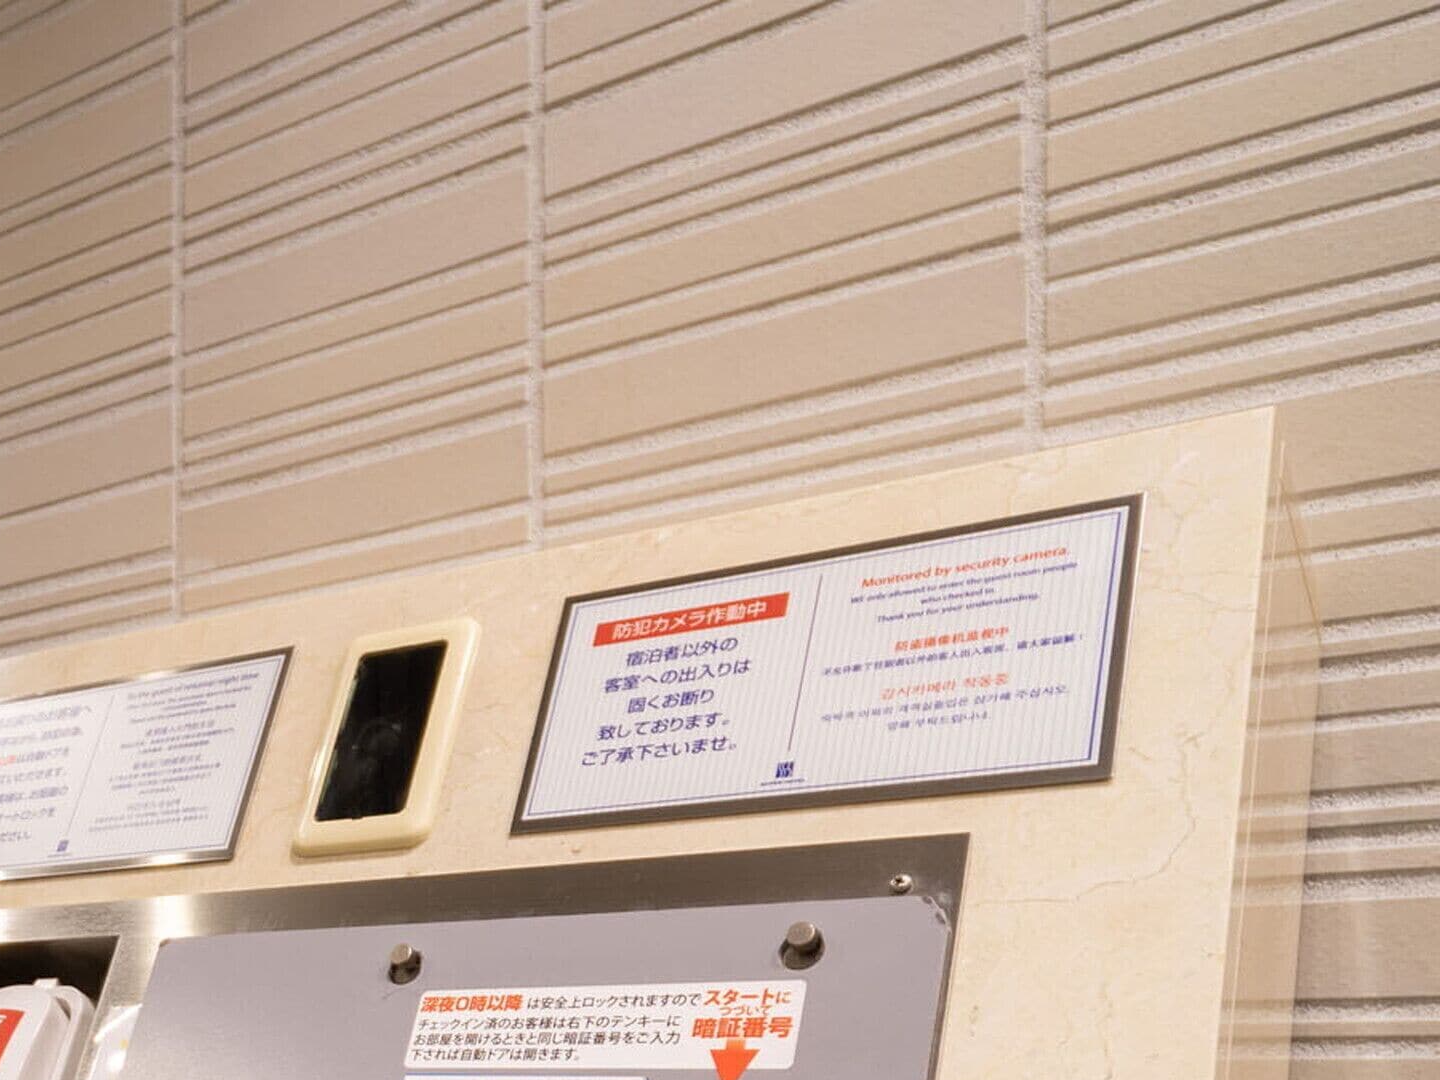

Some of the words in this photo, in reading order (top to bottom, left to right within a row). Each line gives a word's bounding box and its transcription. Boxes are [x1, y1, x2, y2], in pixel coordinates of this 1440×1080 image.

[862, 566, 932, 587] Monitored
[934, 566, 952, 577] by
[956, 557, 1010, 573] security
[888, 586, 926, 598] allowed
[1042, 562, 1078, 575] people
[613, 601, 768, 640] 防犯カメラ作動中
[877, 613, 904, 623] Thank
[906, 610, 924, 620] you
[941, 604, 962, 614] your
[626, 637, 738, 666] 宿泊者以外の
[604, 659, 752, 693] 客室への出入りは
[627, 689, 715, 714] 固くお断り
[597, 712, 730, 741] 致しております。
[582, 737, 736, 766] ご了承下さいませ。
[527, 992, 702, 1011] は安全上ロックされますので
[703, 987, 792, 1006] スタートに
[418, 1015, 681, 1031] チェックイン済のお客様は右下のテンキーに
[691, 1016, 793, 1038] 暗証番号
[413, 1030, 681, 1046] お部屋を開けるときと同じ暗証番号をご入力
[412, 1048, 580, 1062] 下されば自動ドアは開きます。
